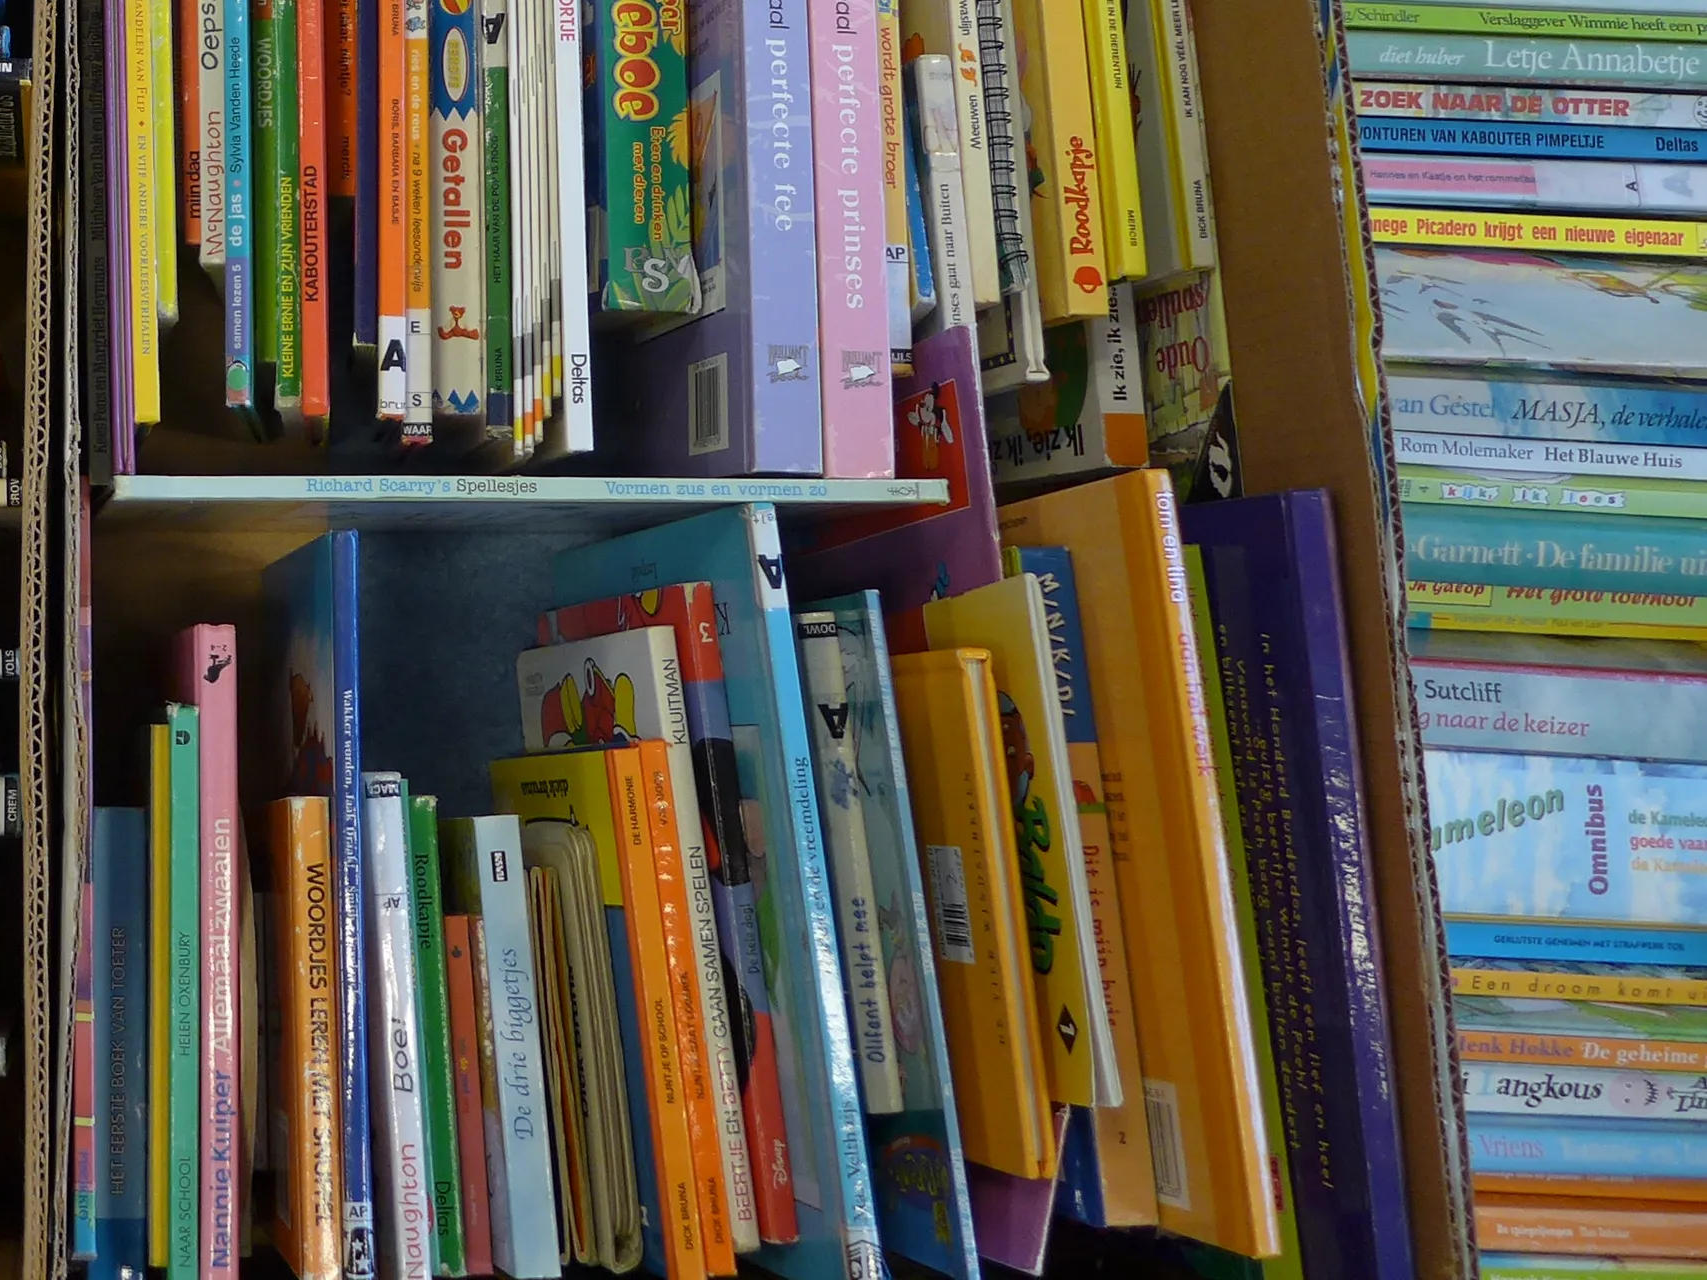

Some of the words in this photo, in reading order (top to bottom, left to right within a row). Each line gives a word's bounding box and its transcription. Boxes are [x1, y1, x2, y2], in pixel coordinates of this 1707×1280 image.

[256, 37, 273, 128] WOORDJES
[1484, 39, 1554, 74] Letje
[1559, 44, 1700, 80] Annabetje
[766, 37, 791, 169] perfecte
[833, 43, 859, 174] perfecte
[1360, 89, 1424, 110] ZOEK
[1432, 91, 1502, 112] NAAR
[1511, 95, 1543, 114] DE
[1552, 96, 1630, 117] OTTER
[1461, 129, 1532, 147] KABOUTER
[1536, 132, 1605, 149] PIMPELTJE
[1655, 135, 1699, 153] Deltas
[442, 128, 471, 269] Getallen
[1070, 136, 1094, 255] Roodkapje
[304, 164, 318, 302] KABOUTERSTAD
[838, 188, 864, 309] prinses
[1416, 217, 1477, 238] Picadero
[1484, 219, 1523, 241] krijgt
[1565, 223, 1616, 244] nieuwe
[1624, 225, 1685, 247] eigenaar
[571, 354, 588, 405] Deltas
[1400, 436, 1438, 454] Rom
[1441, 438, 1534, 460] Molemaker
[1544, 446, 1575, 463] Het
[1577, 448, 1639, 466] Blauwe
[1643, 451, 1683, 469] Huis
[306, 478, 373, 492] Richard
[605, 481, 671, 495] Vormen
[739, 483, 804, 496] vormen
[663, 659, 687, 745] KLUITMAN
[1424, 679, 1502, 704] Sutcliff
[1436, 710, 1489, 731] naar
[1523, 715, 1591, 738] keizer
[1586, 783, 1609, 896] Omnibus
[501, 948, 532, 1042] biggetjes
[392, 1017, 413, 1092] Boe!
[860, 999, 885, 1063] Olifant
[1508, 1038, 1574, 1059] Hokke
[508, 1051, 527, 1096] drie
[1479, 1133, 1544, 1159] Vriens
